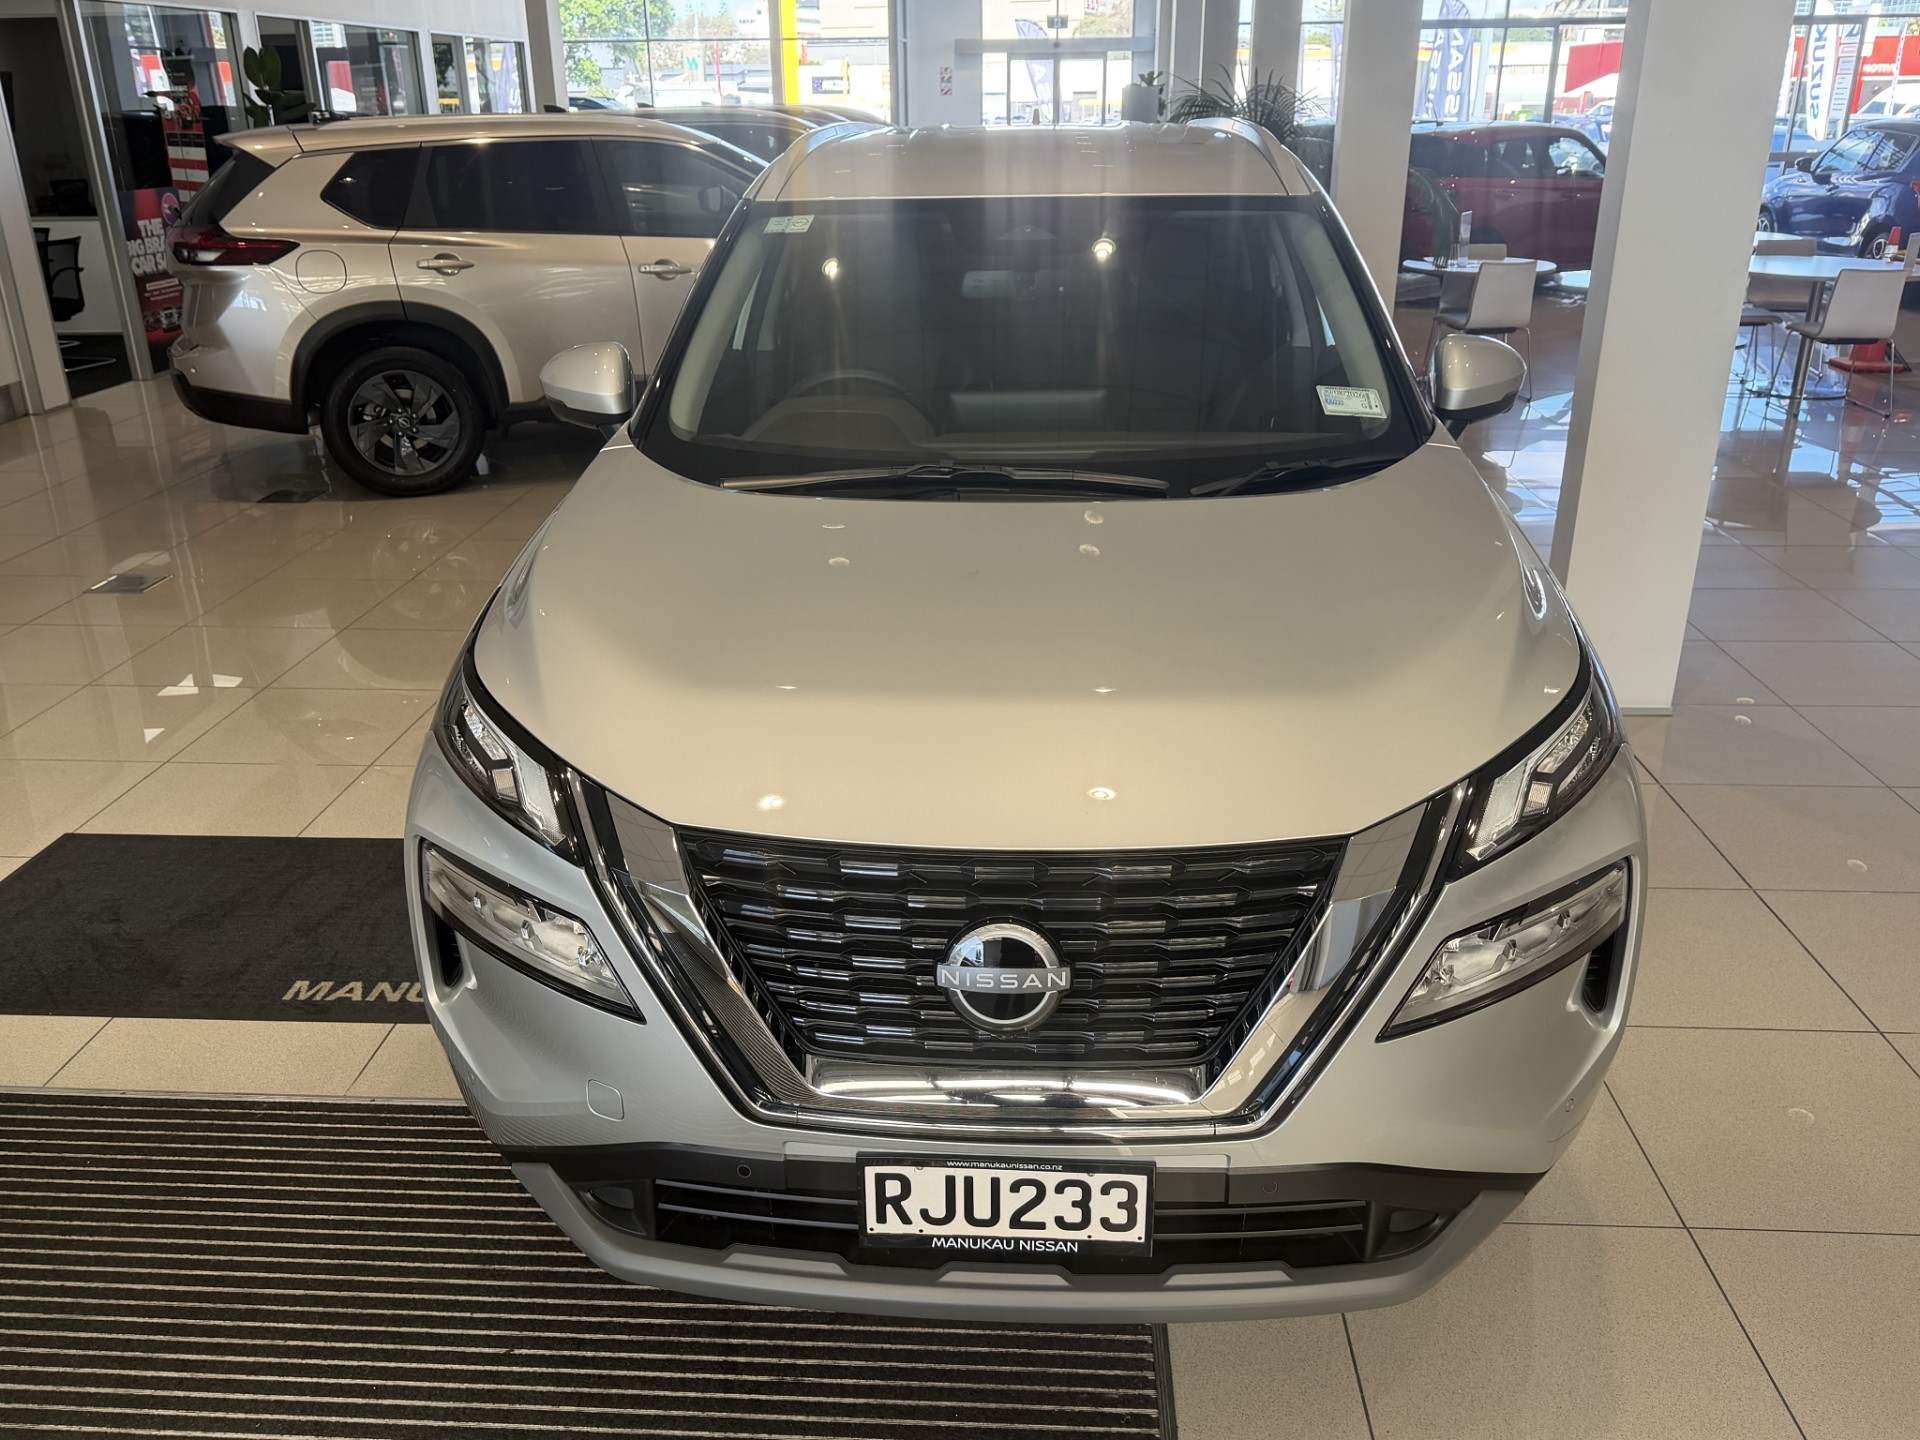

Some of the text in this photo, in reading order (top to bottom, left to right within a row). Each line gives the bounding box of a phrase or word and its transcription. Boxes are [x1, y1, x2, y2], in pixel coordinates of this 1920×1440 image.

[138, 218, 165, 237] THE
[131, 255, 157, 277] CAR
[941, 968, 1066, 989] NISSAN
[946, 1160, 1063, 1171] www.manukaunissan.co.nz
[874, 1172, 1139, 1233] RJU233
[931, 1236, 1078, 1253] MANUKAU NISSAN
